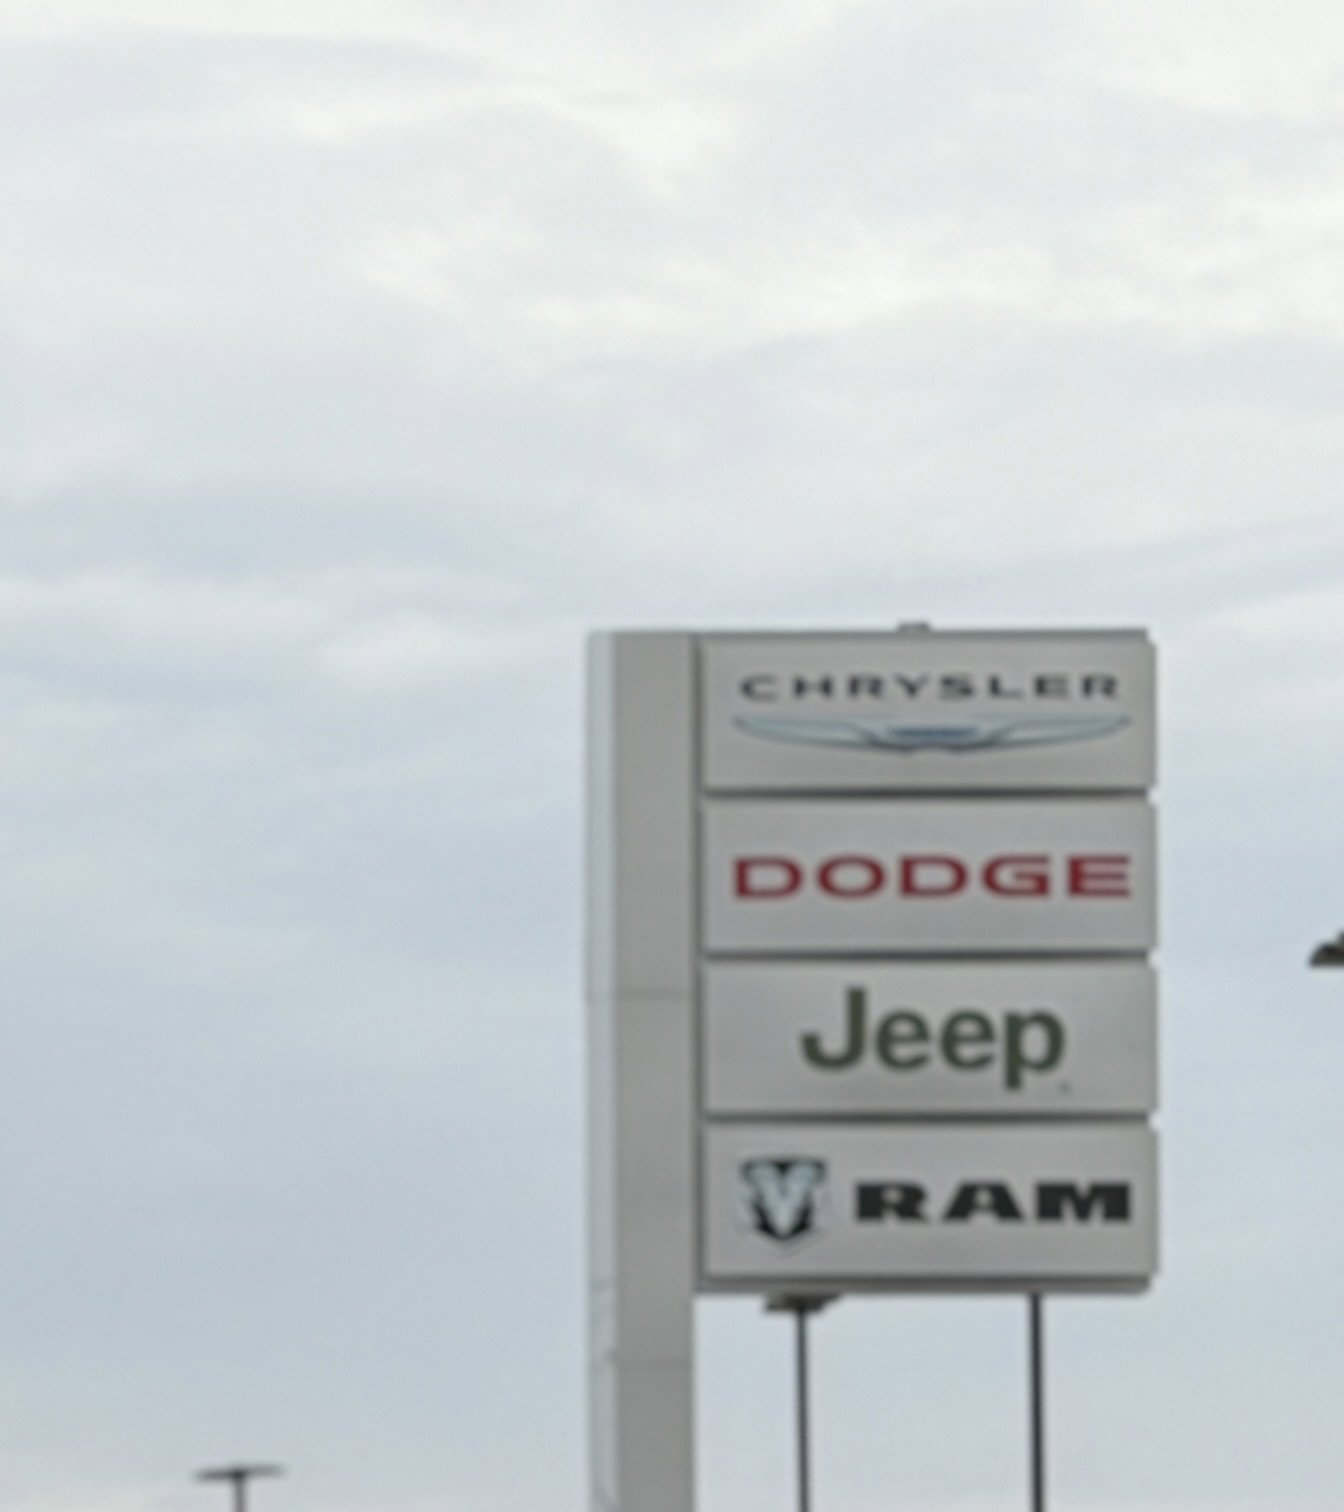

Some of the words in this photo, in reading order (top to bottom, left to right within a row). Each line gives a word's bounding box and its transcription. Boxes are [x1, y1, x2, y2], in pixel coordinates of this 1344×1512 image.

[739, 674, 1118, 700] CHRYSLER
[733, 855, 1130, 899] DODGE
[800, 985, 1066, 1092] Jeep
[855, 1182, 1132, 1223] RAM
